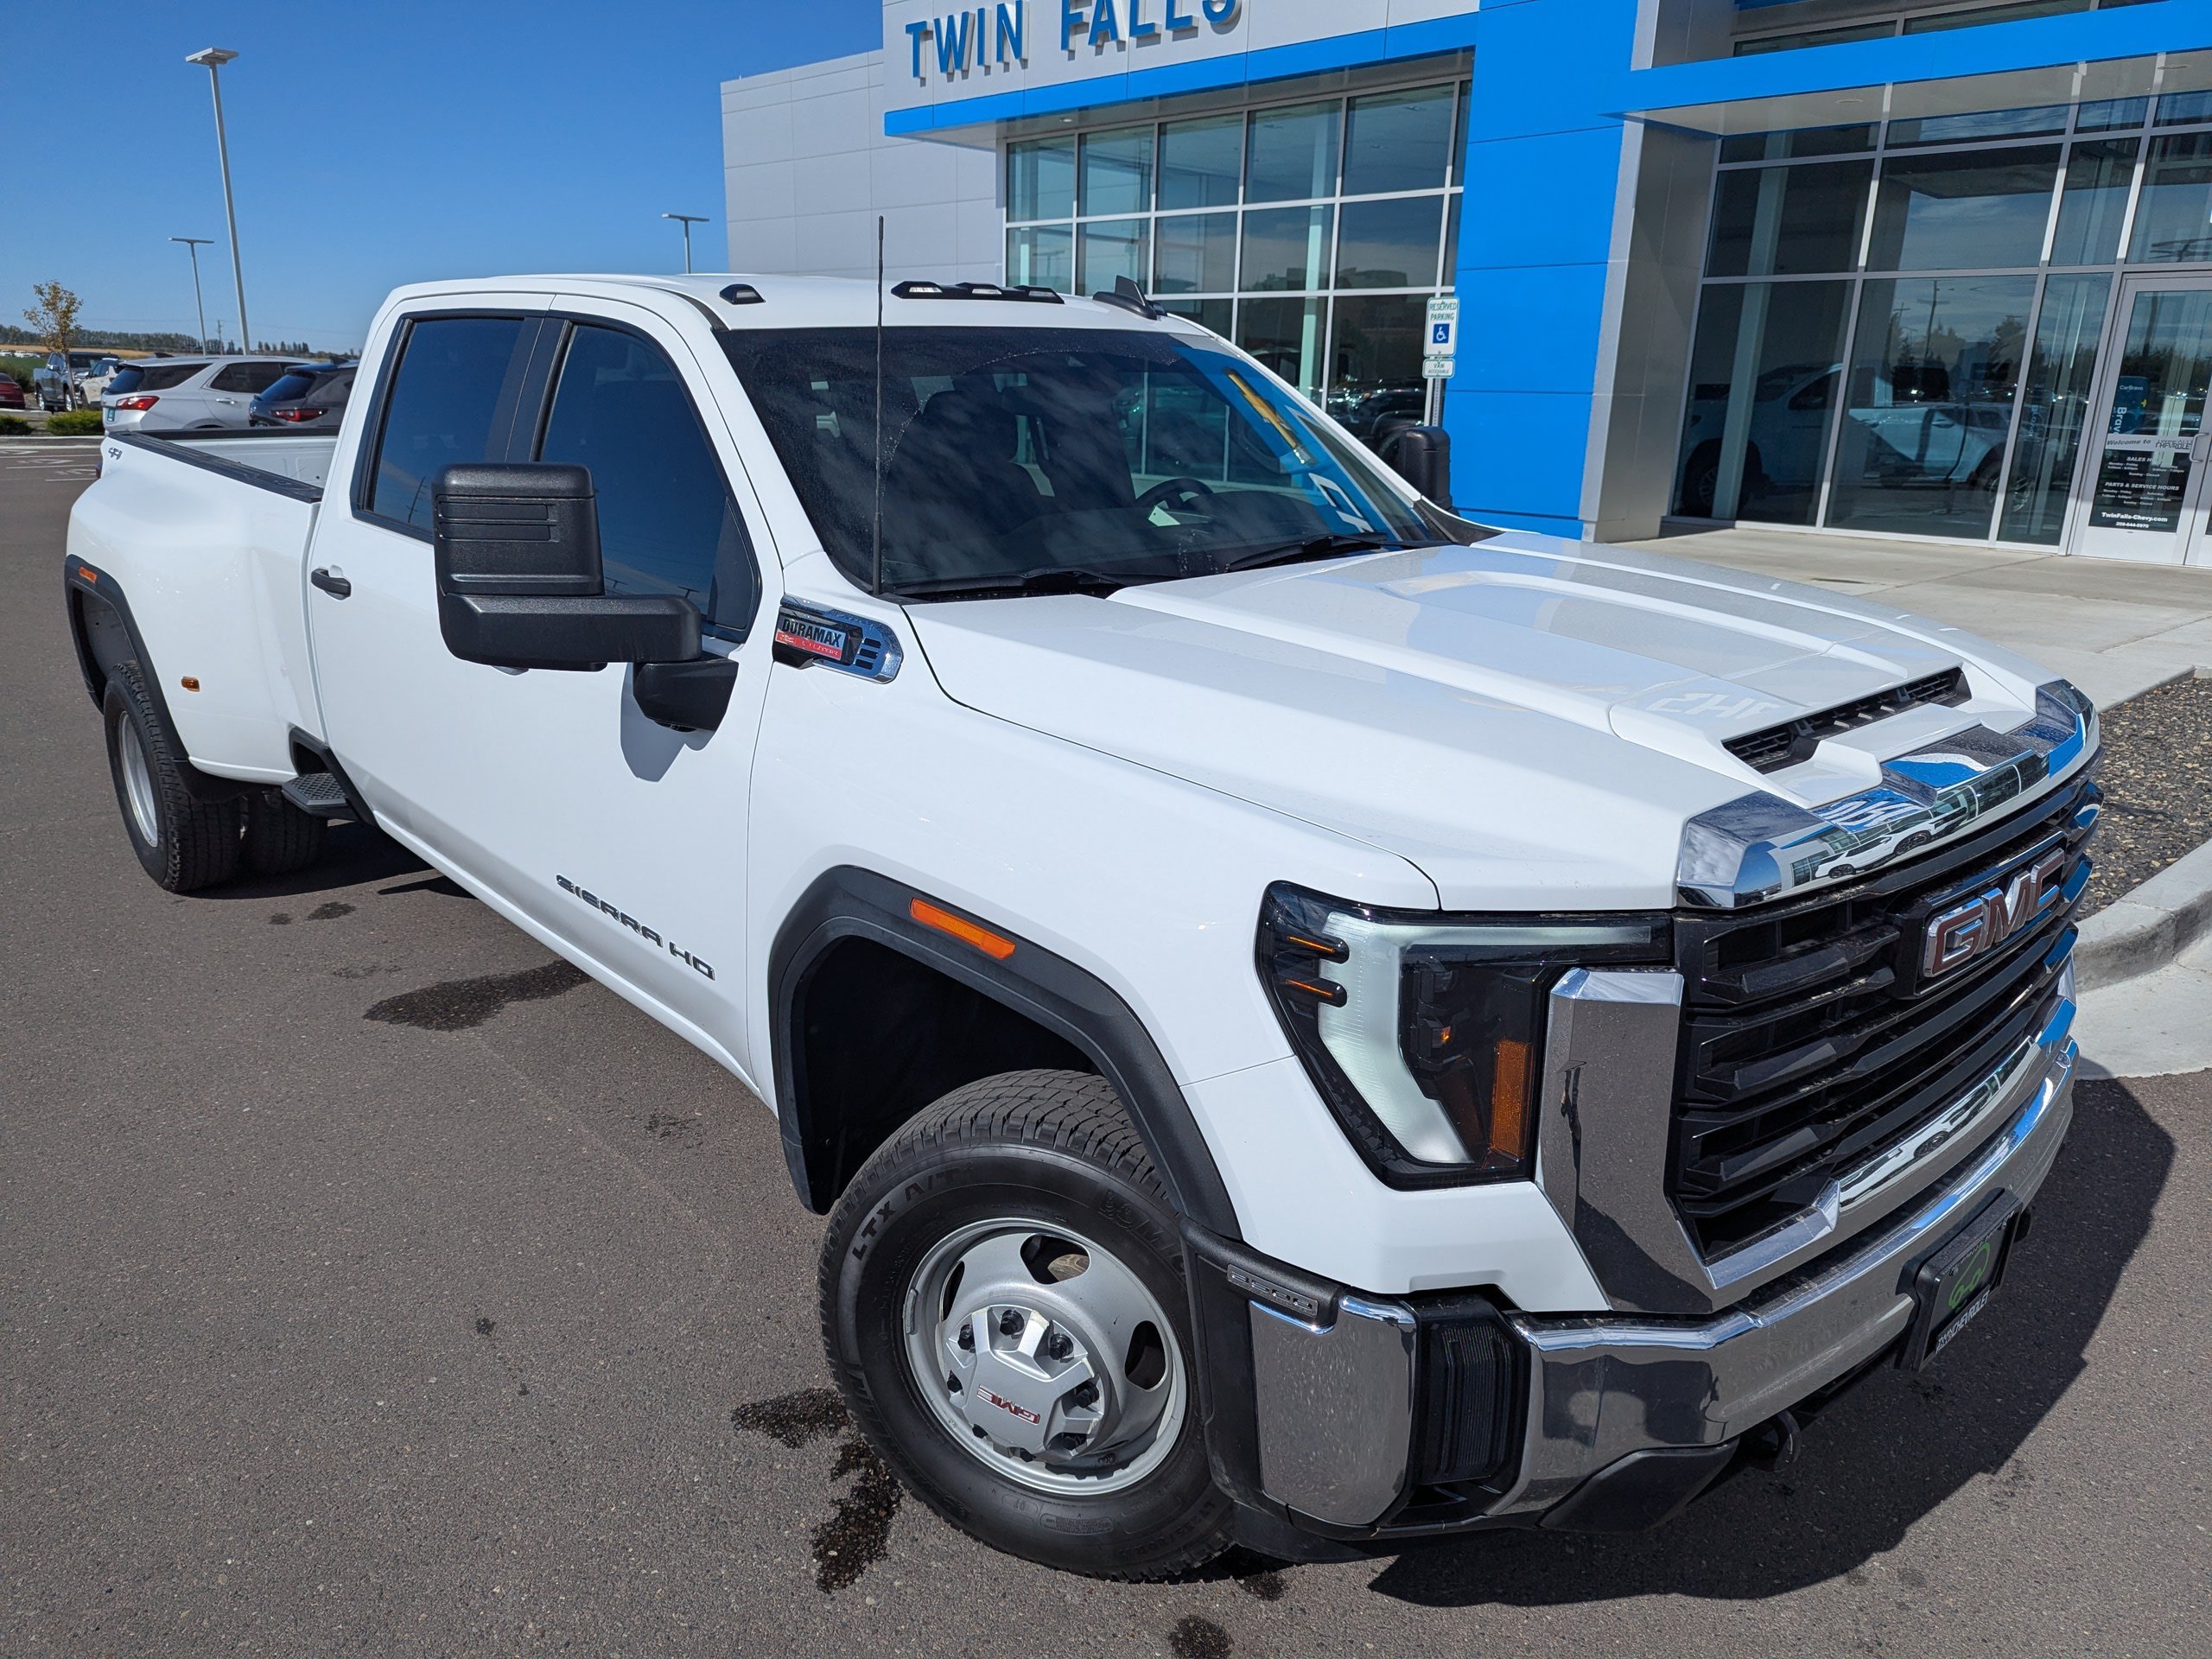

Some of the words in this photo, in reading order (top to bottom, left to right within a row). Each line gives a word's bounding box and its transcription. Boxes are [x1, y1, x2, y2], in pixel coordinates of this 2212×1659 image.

[906, 0, 1027, 79] TWIN
[2101, 512, 2168, 522] TwinFalls-Chevy.com
[782, 618, 842, 648] DURAMAX
[556, 874, 663, 948] SIERRA
[669, 942, 715, 981] HD
[1923, 848, 2064, 977] GMC
[852, 1200, 896, 1261] LTX
[976, 1384, 1040, 1426] GMC
